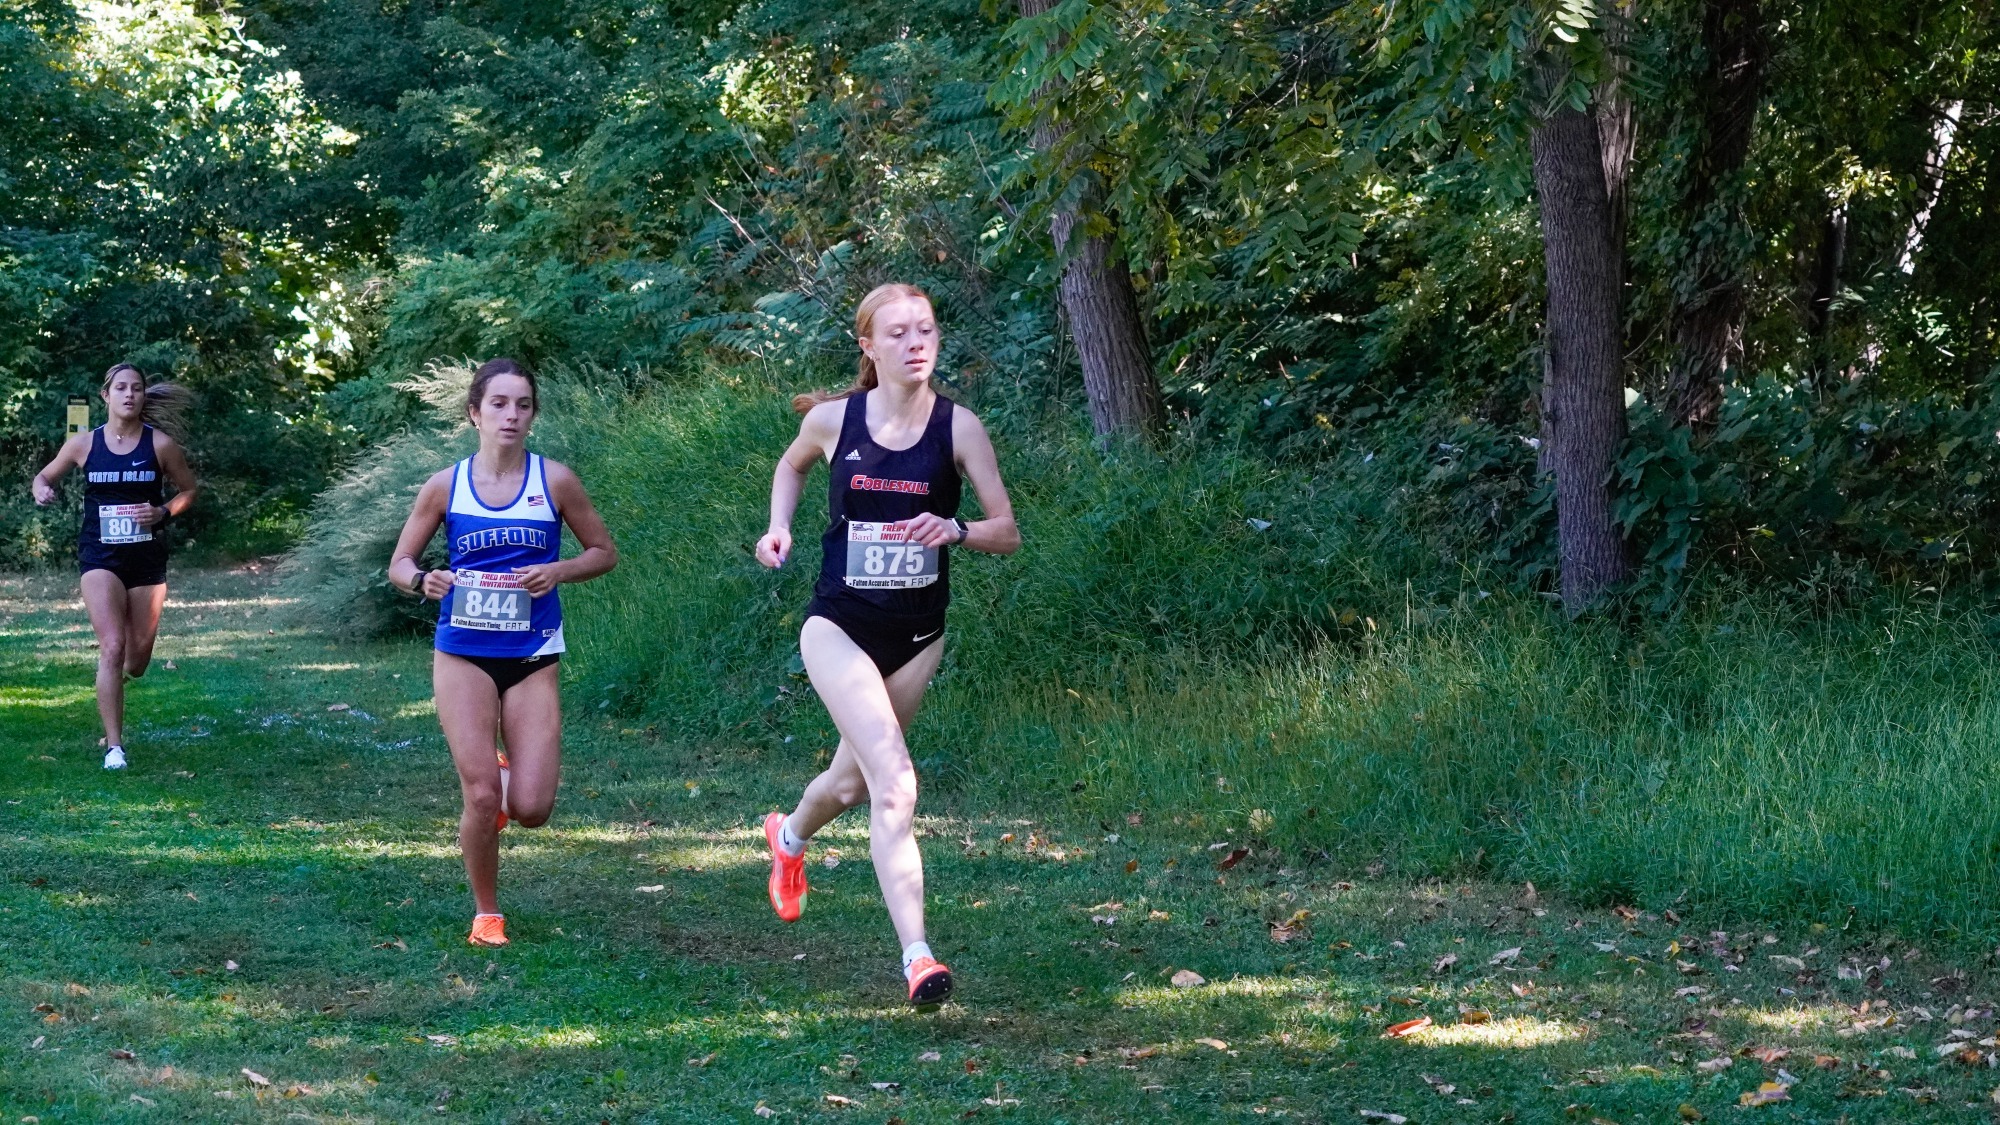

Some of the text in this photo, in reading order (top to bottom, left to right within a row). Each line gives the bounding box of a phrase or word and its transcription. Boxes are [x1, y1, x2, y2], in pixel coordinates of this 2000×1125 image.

[88, 470, 156, 483] STATEN ISLAND
[850, 474, 930, 495] COBLESKILL
[108, 518, 141, 536] 807
[456, 526, 547, 555] SUFFOLK
[852, 532, 873, 541] Bard
[864, 545, 924, 575] 875
[456, 578, 474, 587] Bard
[481, 573, 498, 581] FRED
[852, 579, 906, 588] Fulton Accurate Timing
[465, 590, 519, 619] 844
